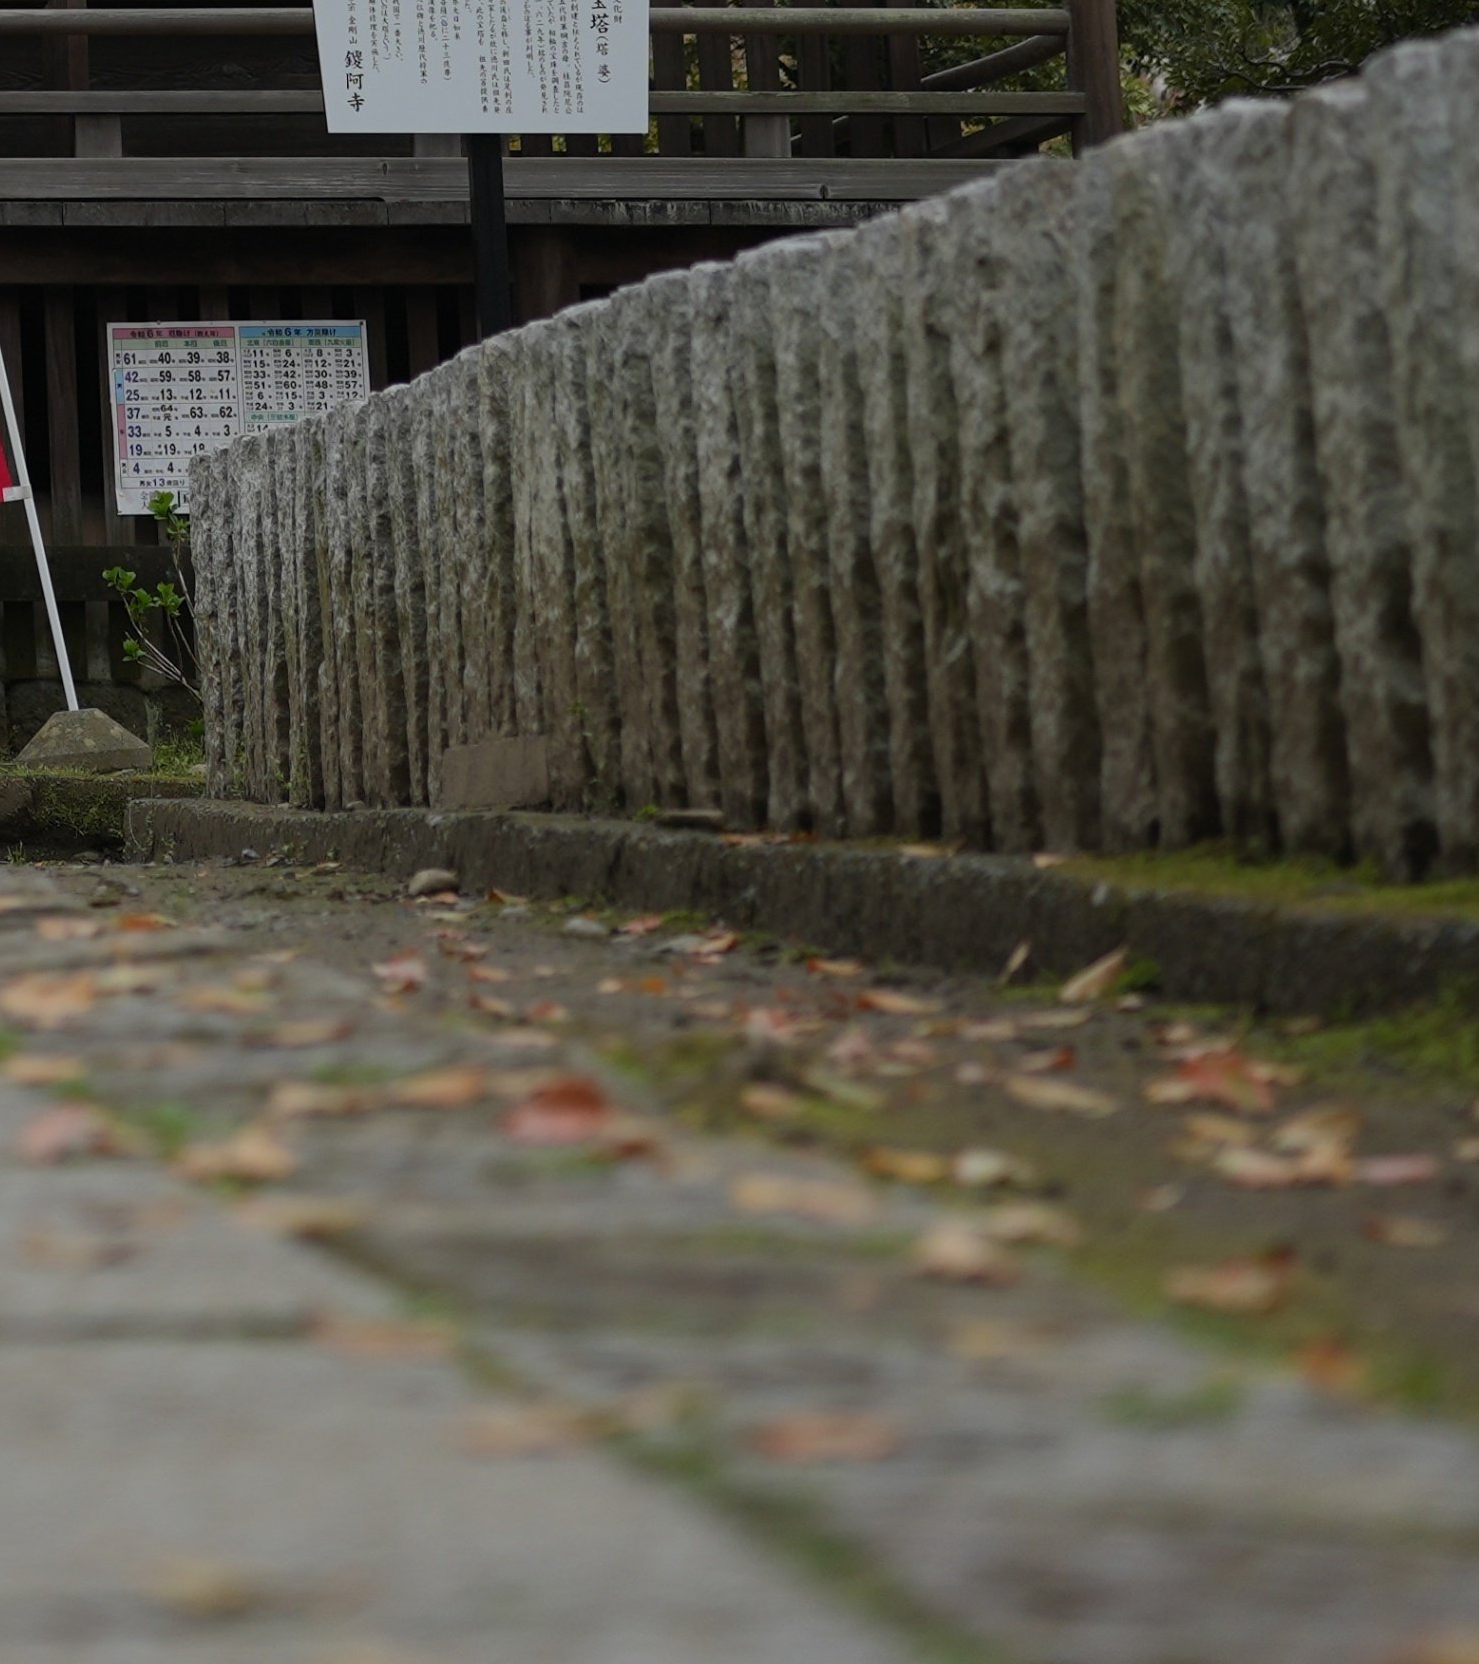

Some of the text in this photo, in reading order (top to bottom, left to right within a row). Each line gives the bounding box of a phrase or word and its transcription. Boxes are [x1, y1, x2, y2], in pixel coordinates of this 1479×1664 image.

[124, 353, 136, 365] 61
[158, 352, 171, 364] 40
[187, 352, 200, 363] 39
[216, 352, 229, 363] 38
[285, 349, 292, 357] 6
[317, 349, 323, 357] 8
[254, 360, 265, 368] 15
[283, 360, 295, 368] 24
[125, 370, 230, 383] 42 59 58 57
[283, 370, 296, 378] 42
[315, 370, 327, 378] 30
[254, 381, 265, 389] 51
[284, 381, 296, 389] 60
[315, 381, 328, 389] 48
[126, 388, 230, 401] 25 13 12 11
[289, 402, 295, 410] 3
[317, 402, 327, 410] 21
[127, 408, 140, 419] 37
[190, 407, 203, 418] 63
[220, 407, 233, 418] 62
[128, 426, 141, 437] 33
[165, 426, 172, 437] 5
[195, 425, 201, 436] 4
[224, 425, 230, 436] 3
[130, 445, 142, 456] 19
[164, 444, 176, 455] 19
[133, 463, 140, 474] 4
[168, 462, 174, 473] 4
